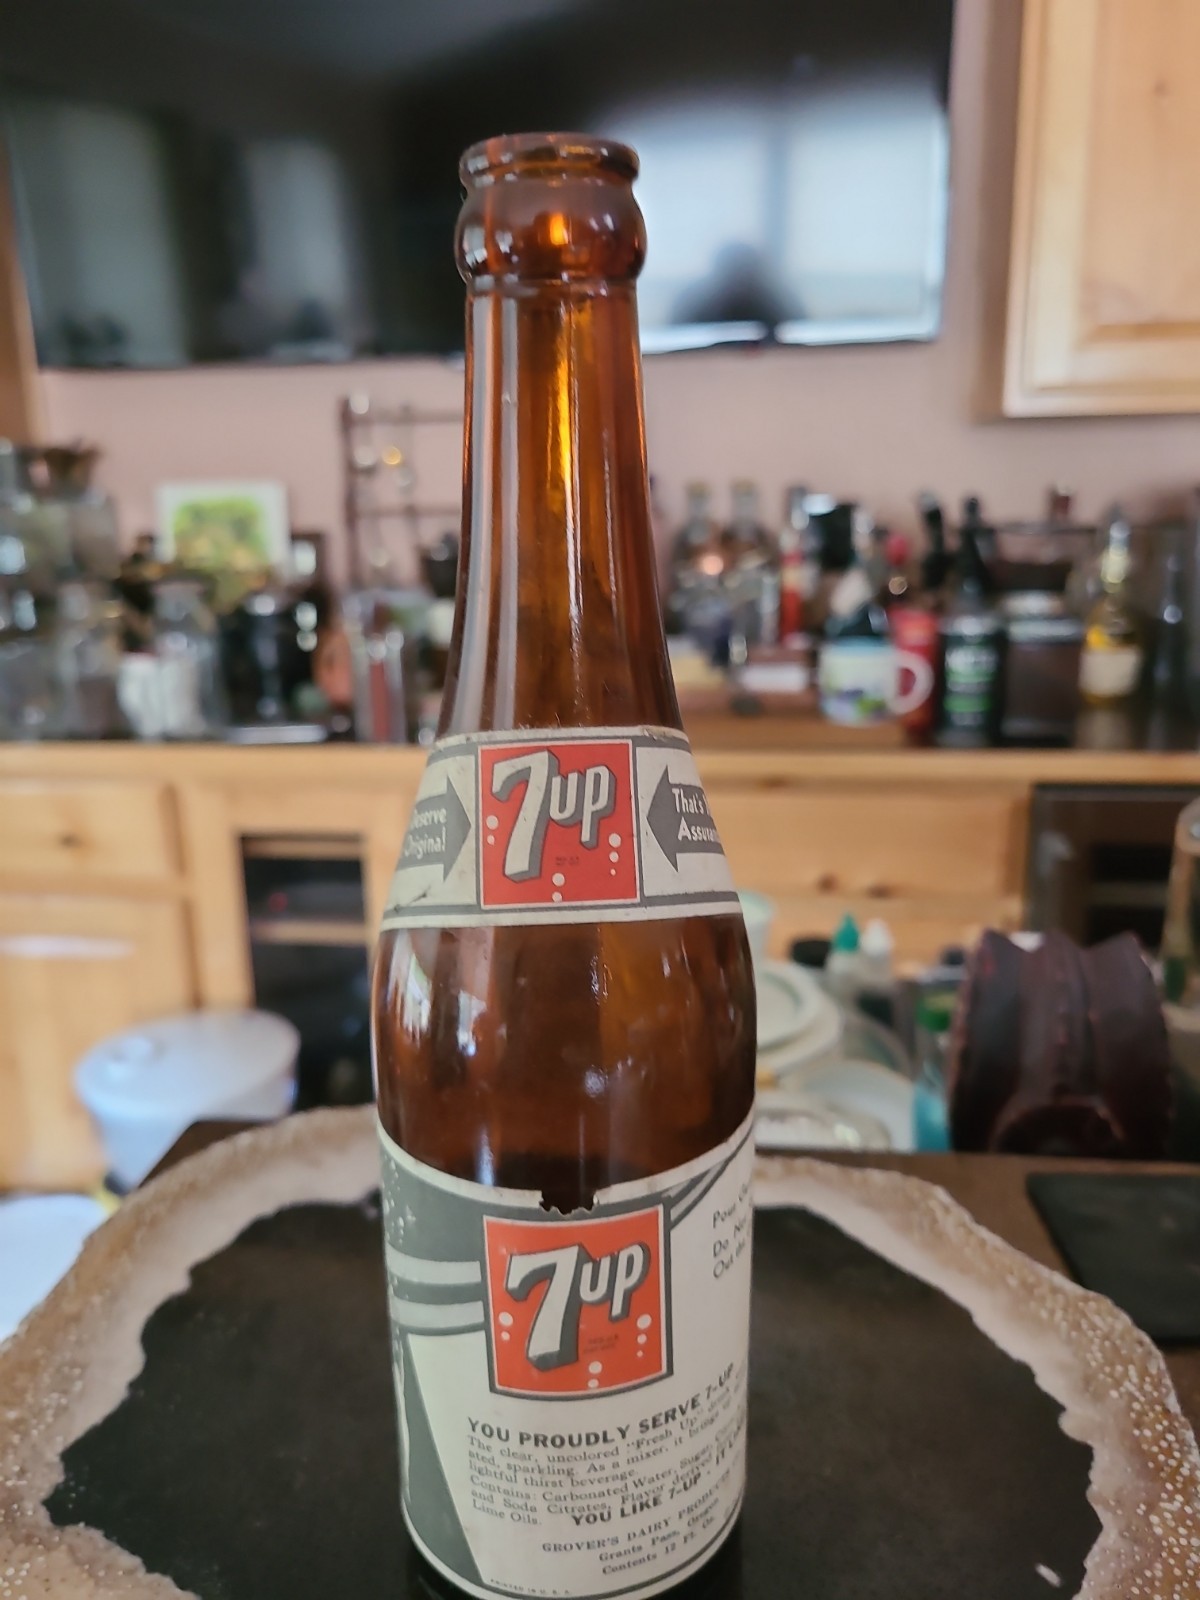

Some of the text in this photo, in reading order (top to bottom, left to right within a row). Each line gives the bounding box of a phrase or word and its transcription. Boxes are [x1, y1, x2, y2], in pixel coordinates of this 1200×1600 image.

[671, 788, 704, 815] That's
[713, 1239, 729, 1258] Do
[468, 1417, 510, 1442] YOU
[519, 1424, 630, 1449] PROUDLY
[639, 1393, 701, 1434] SERVE
[469, 1434, 493, 1453] The
[547, 1446, 619, 1464] uncolored
[587, 1462, 606, 1474] As
[612, 1461, 620, 1470] a
[524, 1476, 564, 1488] thirst
[542, 1483, 629, 1503] Carbonated
[471, 1490, 495, 1505] and
[503, 1498, 538, 1513] Soda
[473, 1498, 505, 1519] Lime
[571, 1509, 613, 1526] YOU
[620, 1496, 662, 1518] LIKE
[542, 1535, 620, 1553] GROVER'S
[627, 1516, 671, 1542] DAIRY
[598, 1544, 643, 1562] Grants
[602, 1552, 658, 1576] Contents
